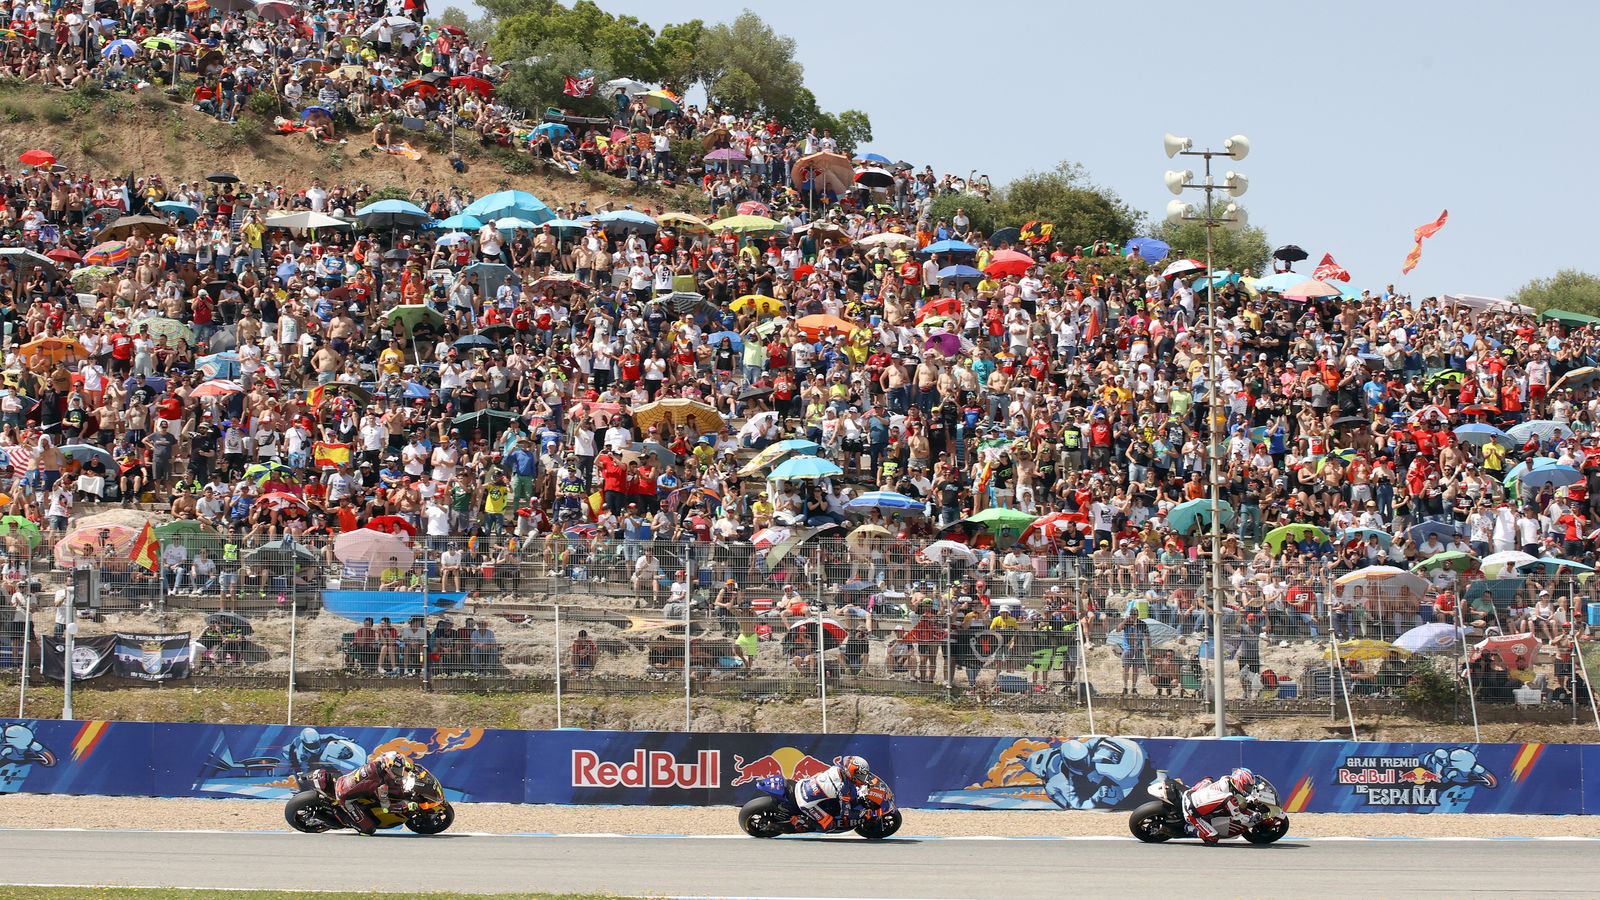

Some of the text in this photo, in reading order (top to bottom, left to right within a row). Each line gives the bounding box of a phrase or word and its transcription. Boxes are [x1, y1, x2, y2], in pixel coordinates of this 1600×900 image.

[572, 749, 720, 788] Red Bull
[1347, 758, 1419, 767] GRAN PREMIO
[1339, 769, 1395, 783] Red Bull
[1356, 785, 1368, 793] DE
[1368, 785, 1438, 805] ESPAÑA
